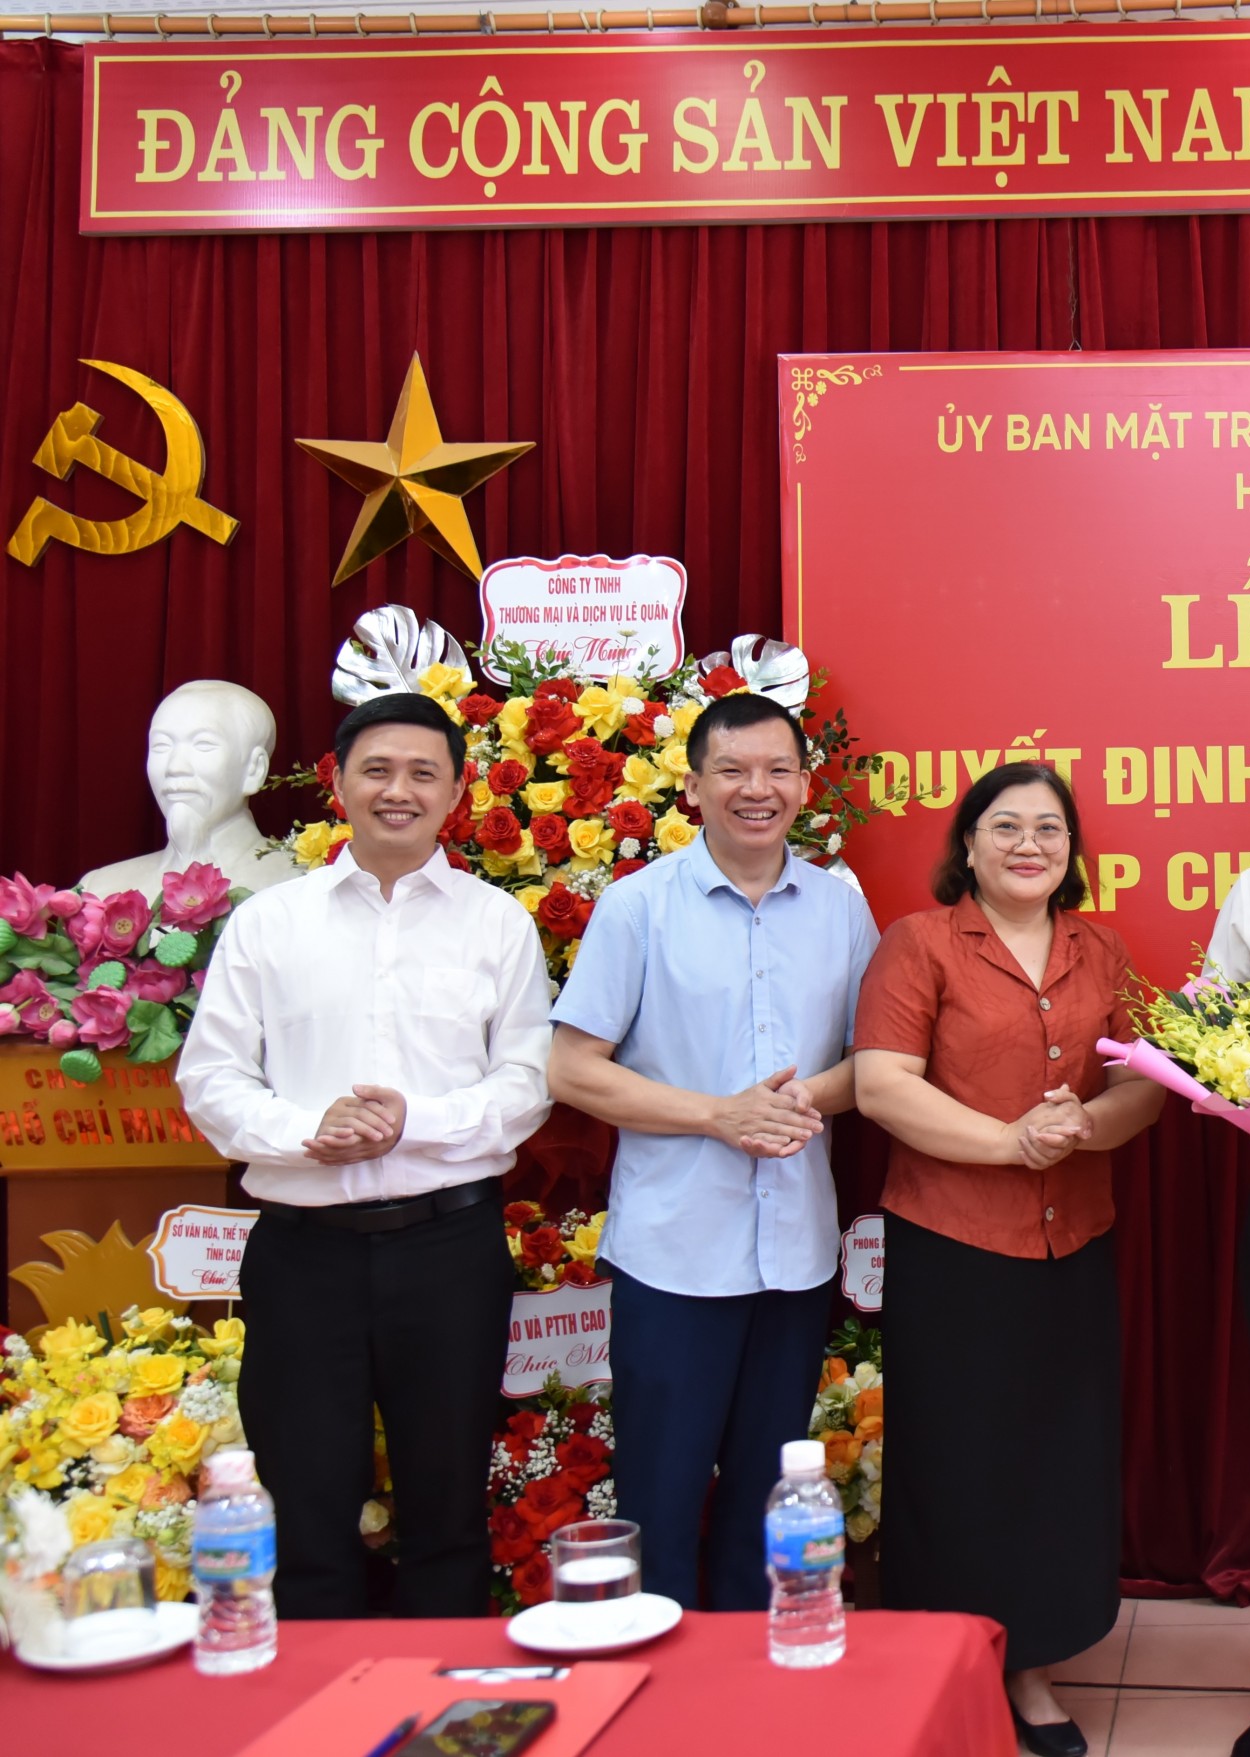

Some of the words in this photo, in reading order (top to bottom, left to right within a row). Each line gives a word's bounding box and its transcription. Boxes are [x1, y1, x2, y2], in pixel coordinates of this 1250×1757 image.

[135, 70, 385, 183] ĐẢNG
[409, 75, 649, 198] CỘNG
[673, 60, 848, 174] SẢN
[875, 66, 1079, 188] VIỆT
[938, 403, 992, 453] ỦY
[1007, 413, 1090, 451] BAN
[1106, 403, 1192, 460] MẶT
[548, 574, 576, 595] CÔNG
[580, 577, 592, 594] TY
[594, 576, 621, 594] TNHH
[499, 605, 540, 624] THƯƠNG
[543, 606, 563, 627] MẠI
[567, 602, 579, 623] VÀ
[582, 604, 607, 626] DỊCH
[610, 604, 623, 625] VỤ
[625, 601, 637, 621] LÊ
[103, 1067, 172, 1095] TỊCH
[53, 1099, 114, 1145] CHÍ
[119, 1106, 207, 1144] MIN
[185, 1222, 201, 1238] VĂN
[226, 1249, 241, 1262] CAO
[524, 1315, 542, 1340] VÀ
[545, 1313, 577, 1337] PTTH
[581, 1308, 606, 1333] CAO
